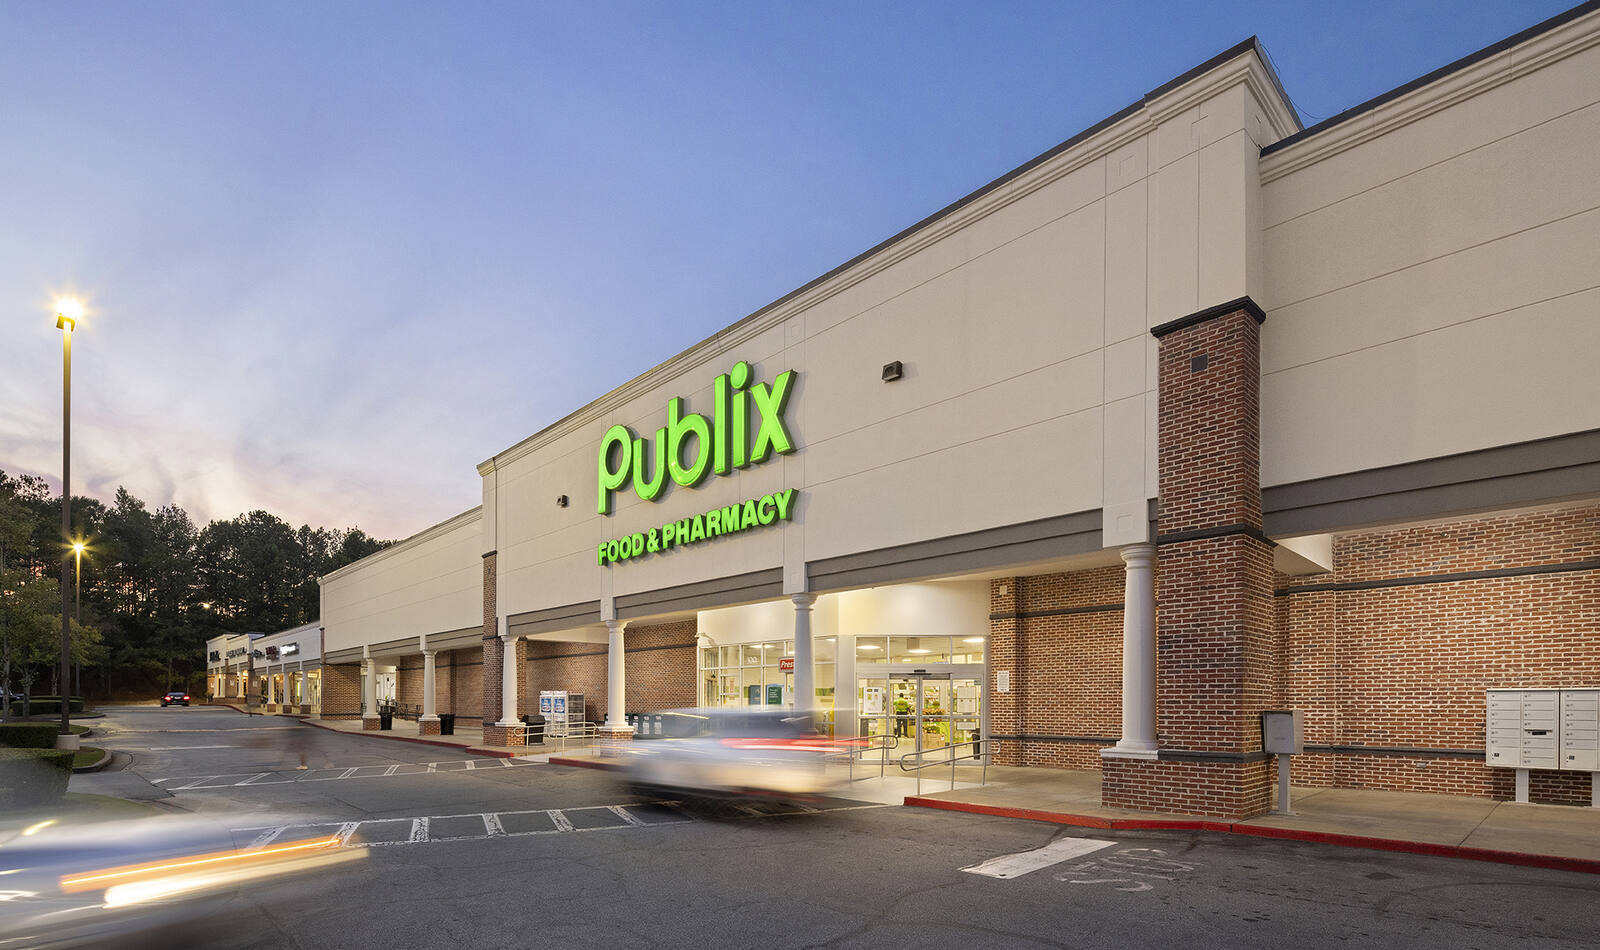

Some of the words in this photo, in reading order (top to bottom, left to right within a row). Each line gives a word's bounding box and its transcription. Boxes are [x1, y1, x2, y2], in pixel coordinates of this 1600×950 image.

[598, 532, 645, 566] FOOD
[647, 528, 661, 553] &
[662, 488, 799, 549] PHARMACY
